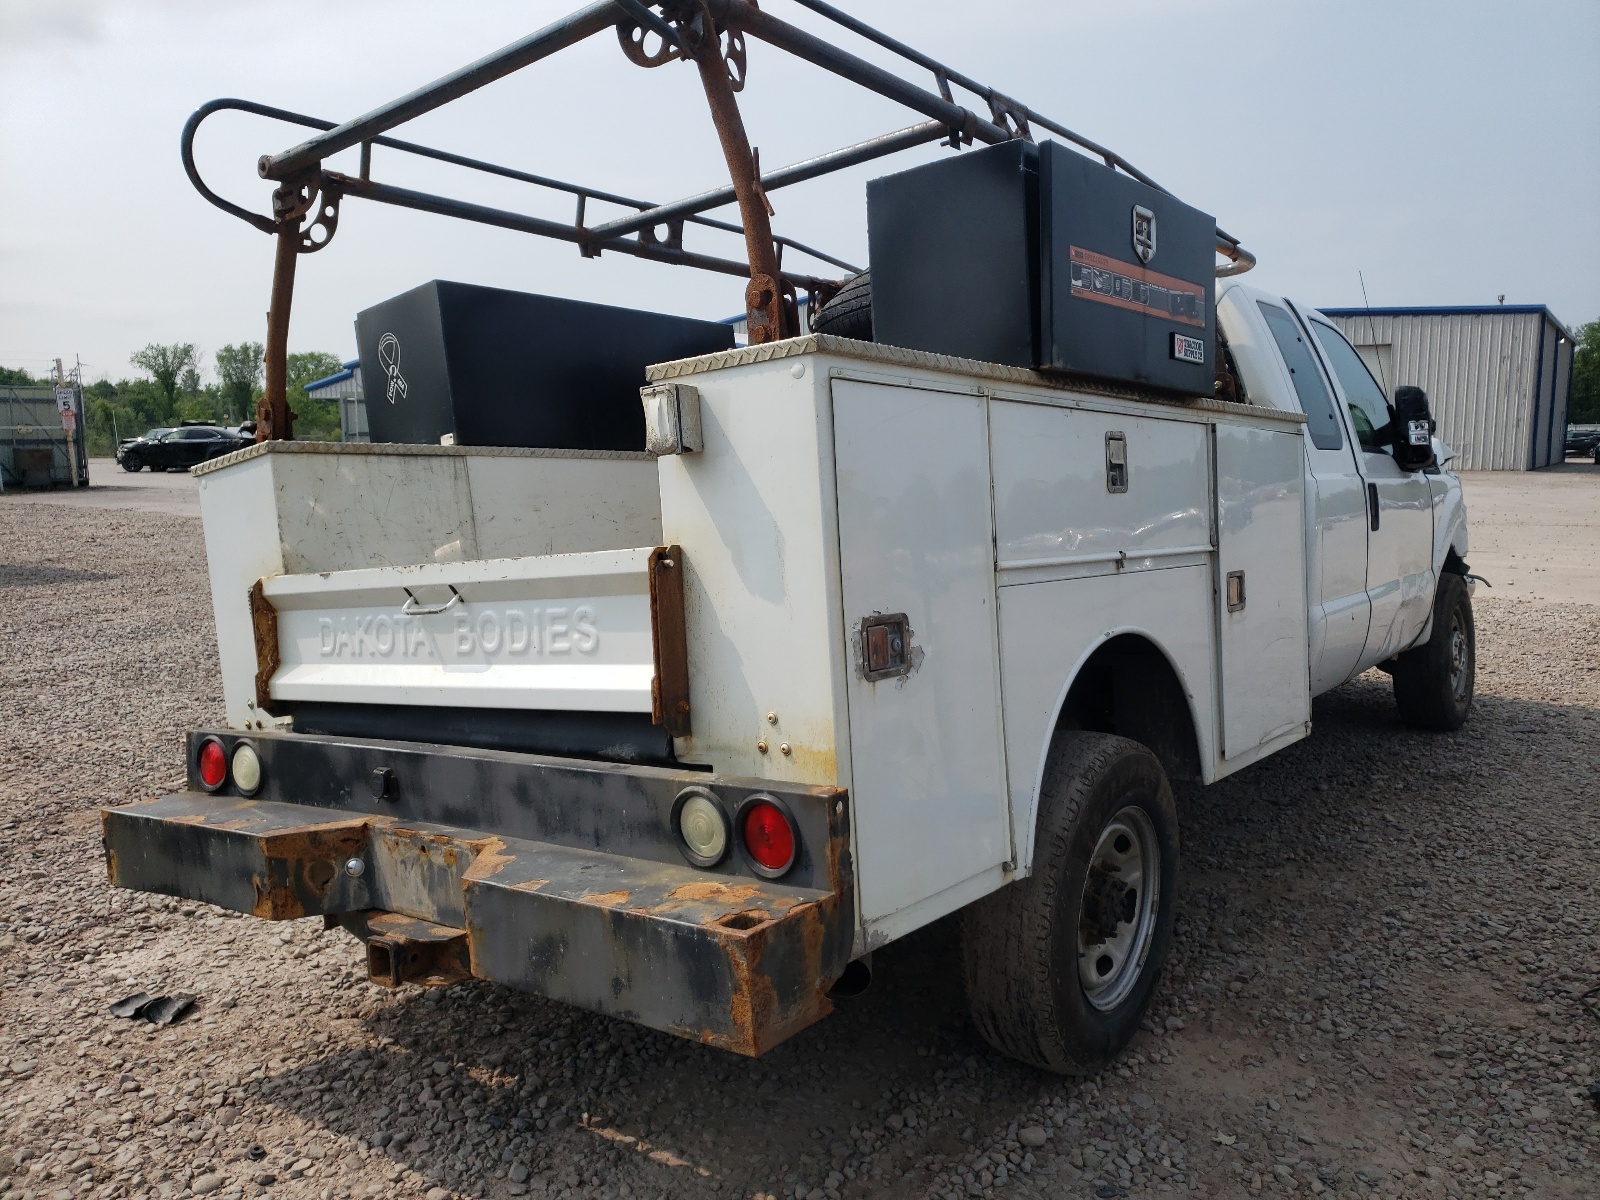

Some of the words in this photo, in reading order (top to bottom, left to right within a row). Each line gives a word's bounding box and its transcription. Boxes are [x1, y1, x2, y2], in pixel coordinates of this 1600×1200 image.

[62, 401, 71, 410] 5
[319, 613, 436, 658] DAKOTA
[453, 605, 598, 656] BODIES
